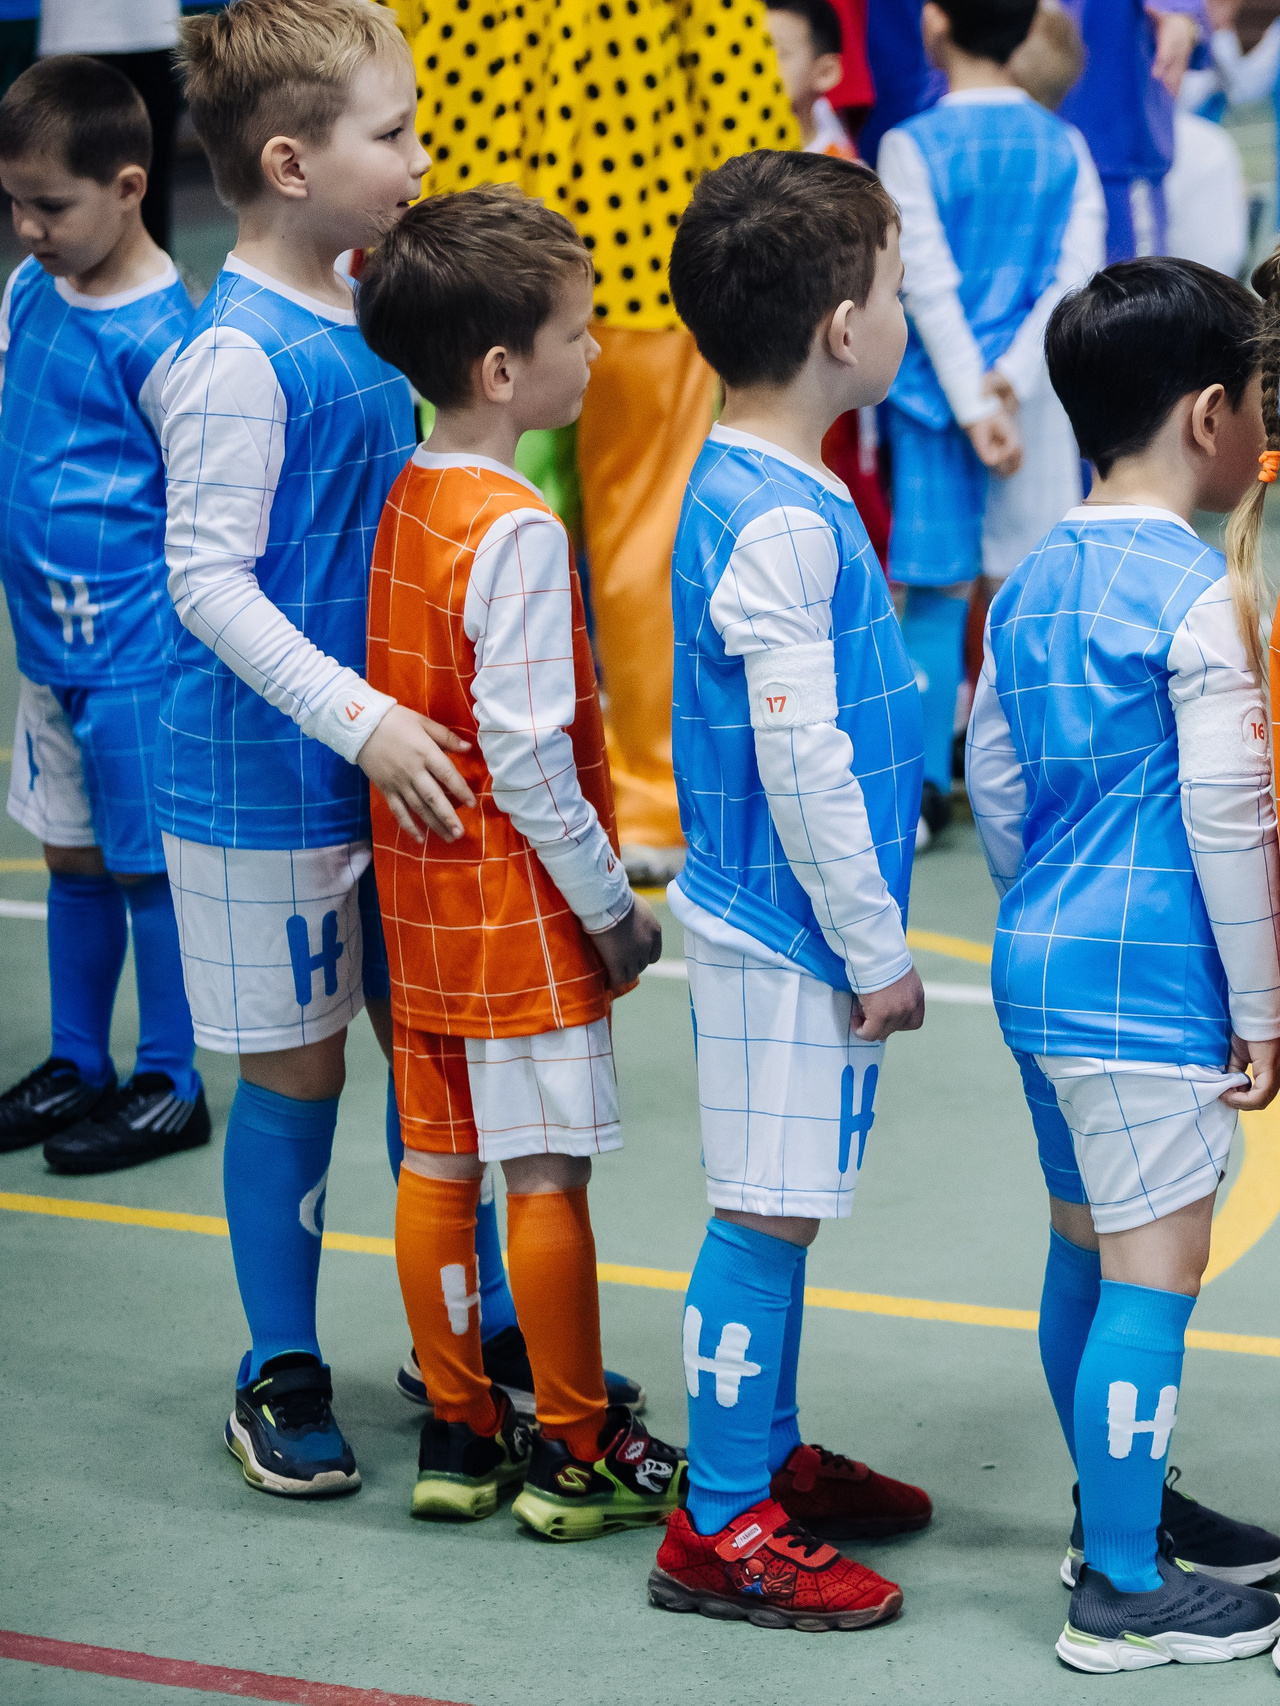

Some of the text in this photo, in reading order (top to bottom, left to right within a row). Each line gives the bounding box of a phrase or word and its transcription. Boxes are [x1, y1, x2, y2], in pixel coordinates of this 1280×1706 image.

[345, 700, 366, 721] 17
[765, 695, 787, 714] 17
[1250, 722, 1265, 741] 16
[286, 909, 344, 1007] H
[838, 1063, 879, 1174] H
[683, 1304, 762, 1408] H
[1107, 1380, 1178, 1460] H
